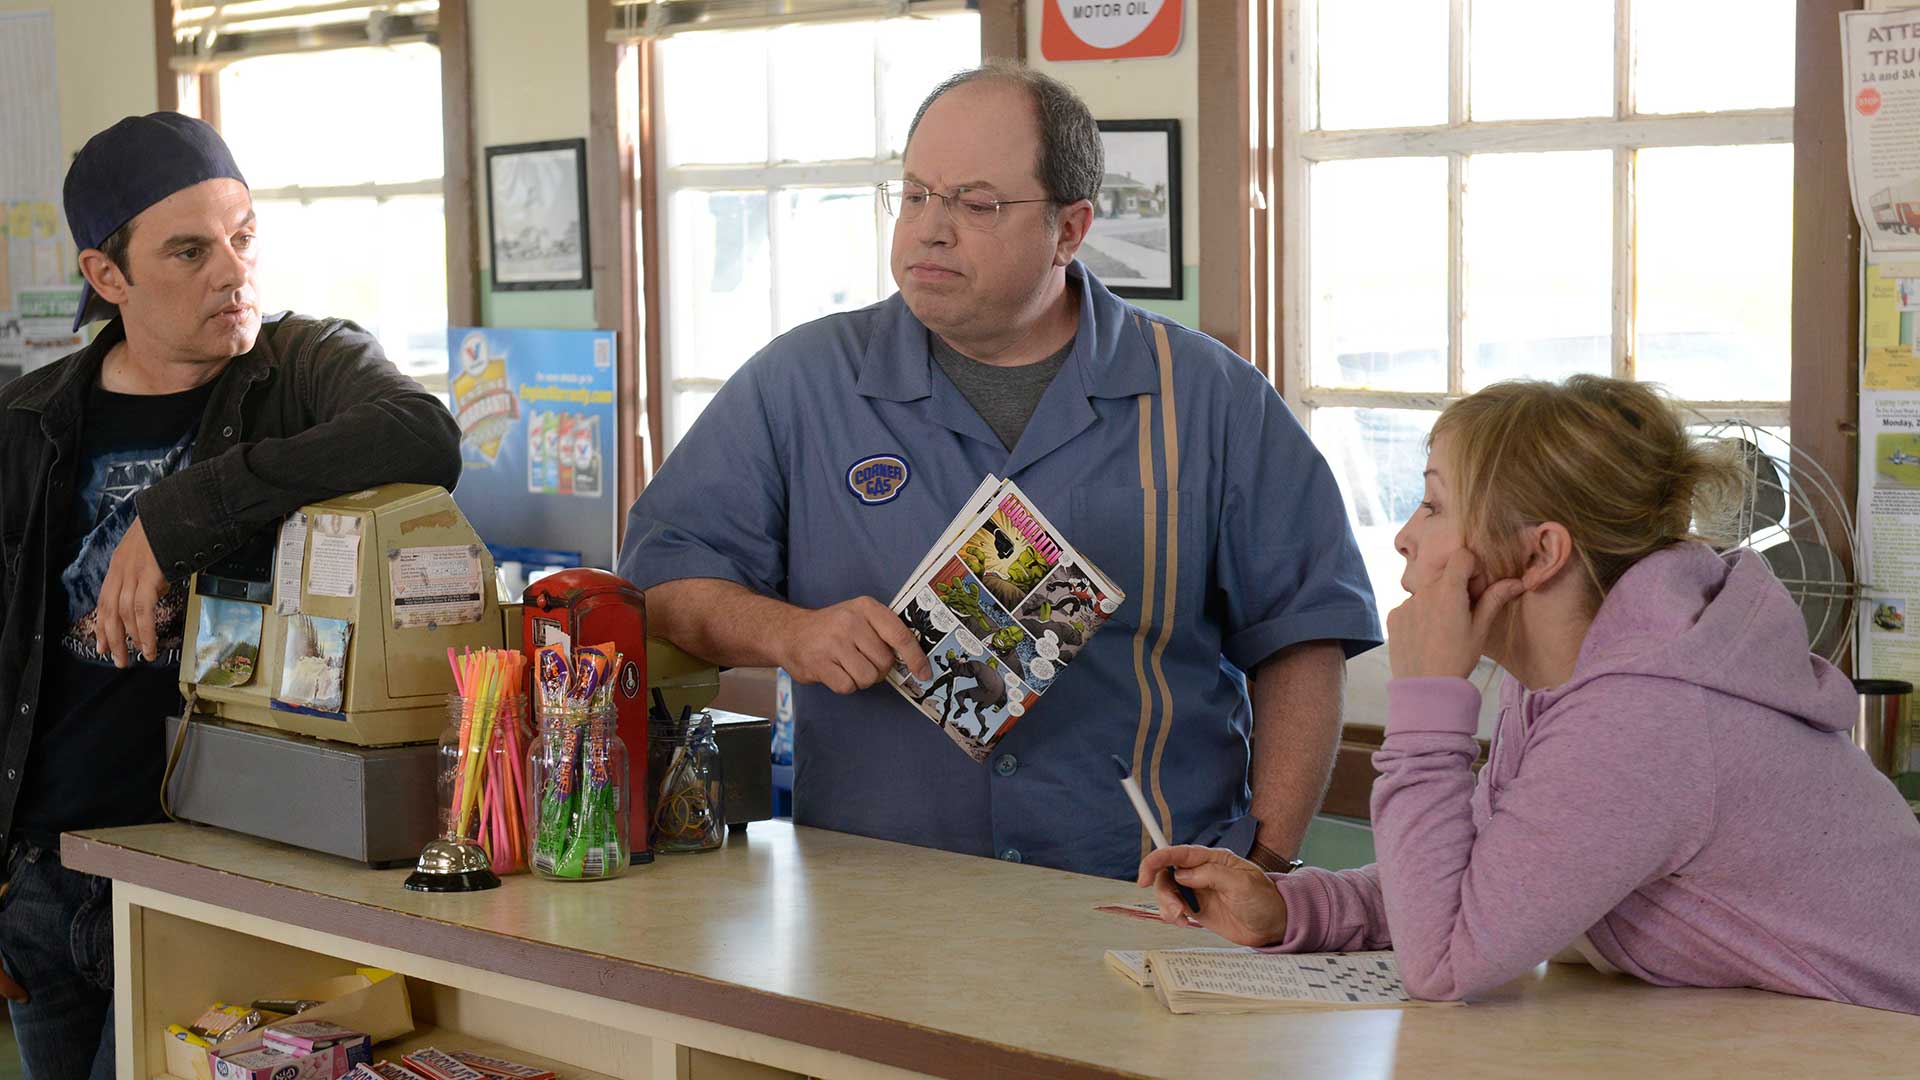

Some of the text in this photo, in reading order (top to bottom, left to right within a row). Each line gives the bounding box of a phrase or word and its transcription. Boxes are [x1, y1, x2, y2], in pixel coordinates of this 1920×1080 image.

[1073, 2, 1150, 19] MOTOR OIL
[1868, 47, 1920, 67] TRU
[1879, 71, 1899, 81] and
[854, 463, 902, 485] CORNER
[866, 477, 892, 496] GAS
